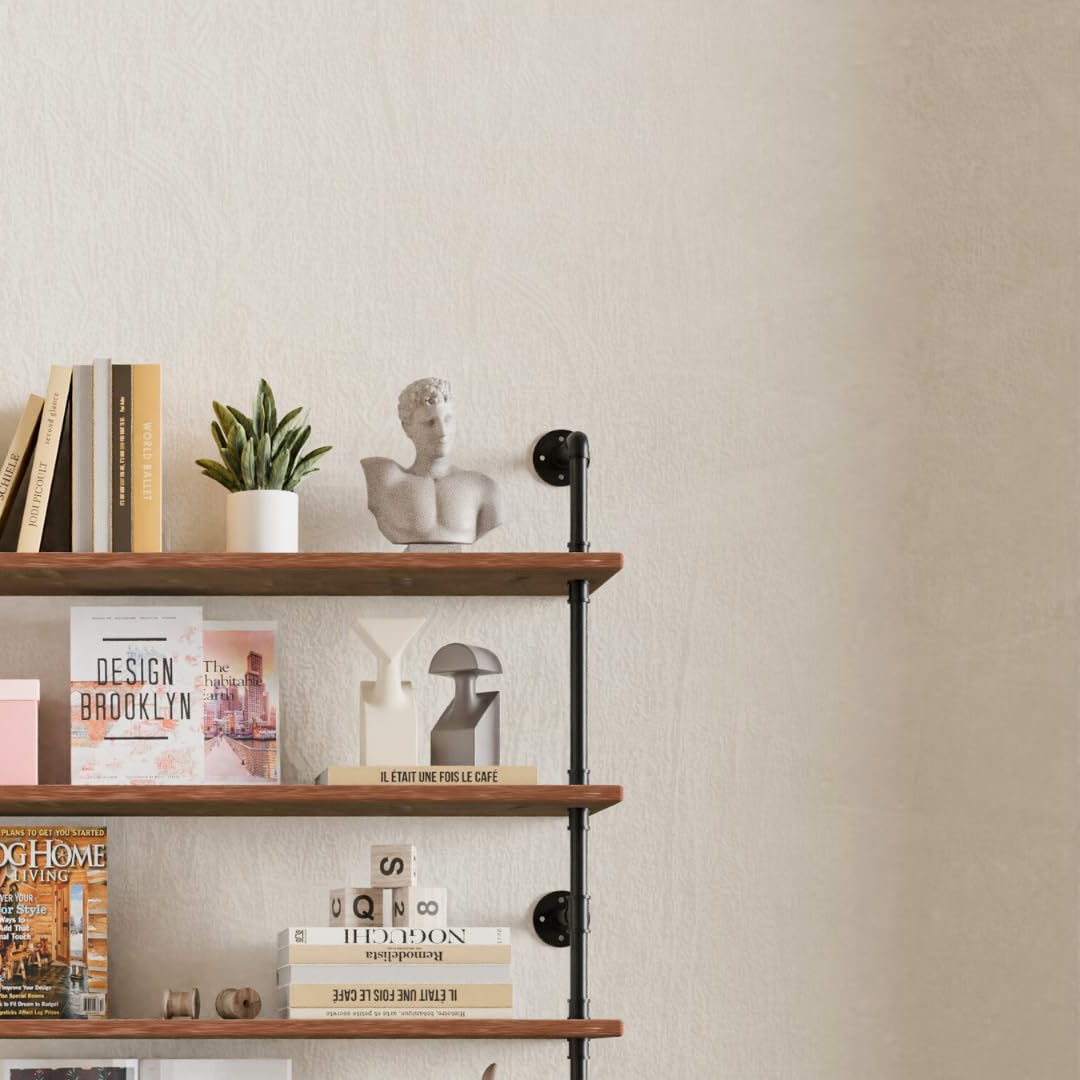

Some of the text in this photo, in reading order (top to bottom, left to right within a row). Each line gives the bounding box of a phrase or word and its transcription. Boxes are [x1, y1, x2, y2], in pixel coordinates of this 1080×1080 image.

[143, 422, 153, 501] WORLD BALLET
[29, 462, 48, 527] JODI PICOULT
[97, 658, 173, 685] DESIGN
[203, 660, 230, 672] The
[203, 688, 234, 701] arth
[81, 692, 191, 721] BROOKLYN
[380, 769, 498, 783] IL ÉTAIT UNE FOIS LE CAFÉ
[1, 829, 25, 837] PLANS
[27, 829, 37, 837] TO
[39, 829, 52, 837] GET
[55, 829, 70, 837] YOU
[72, 829, 105, 837] STARTED
[380, 857, 404, 876] S
[15, 869, 69, 882] LIVING
[15, 894, 34, 902] YOUR
[16, 904, 47, 917] Style
[353, 895, 374, 921] Q
[417, 901, 439, 916] 8
[344, 929, 466, 944] NOGUCHI
[366, 951, 443, 963] Remodelista
[332, 989, 458, 1004] IL ÉTAIT UNE FOIS LE CAFÉ
